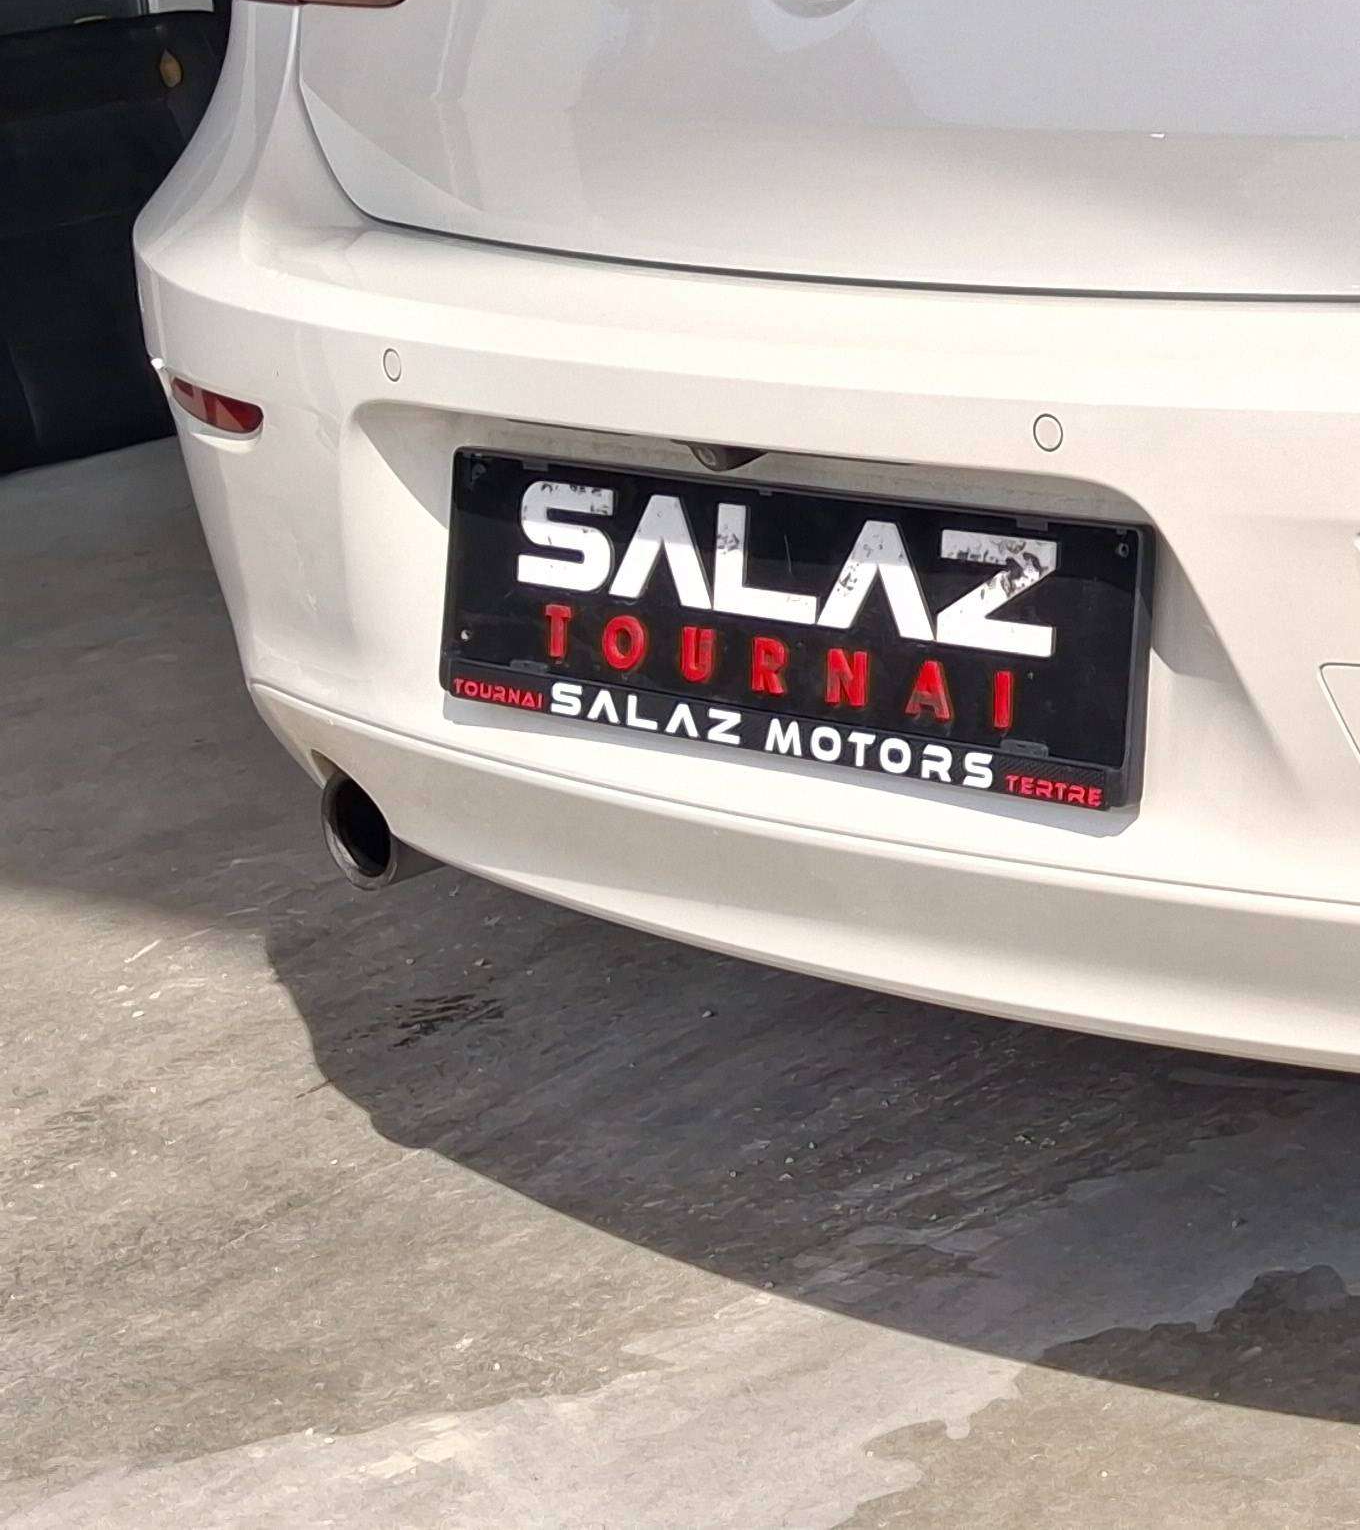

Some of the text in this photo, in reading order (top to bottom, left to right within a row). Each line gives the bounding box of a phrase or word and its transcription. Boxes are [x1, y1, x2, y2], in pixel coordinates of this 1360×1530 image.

[516, 479, 1058, 658] SALAZ
[544, 604, 1014, 729] TOURNAI
[453, 677, 1103, 808] TOURNAI SALAZ MOTORS TERTRE
